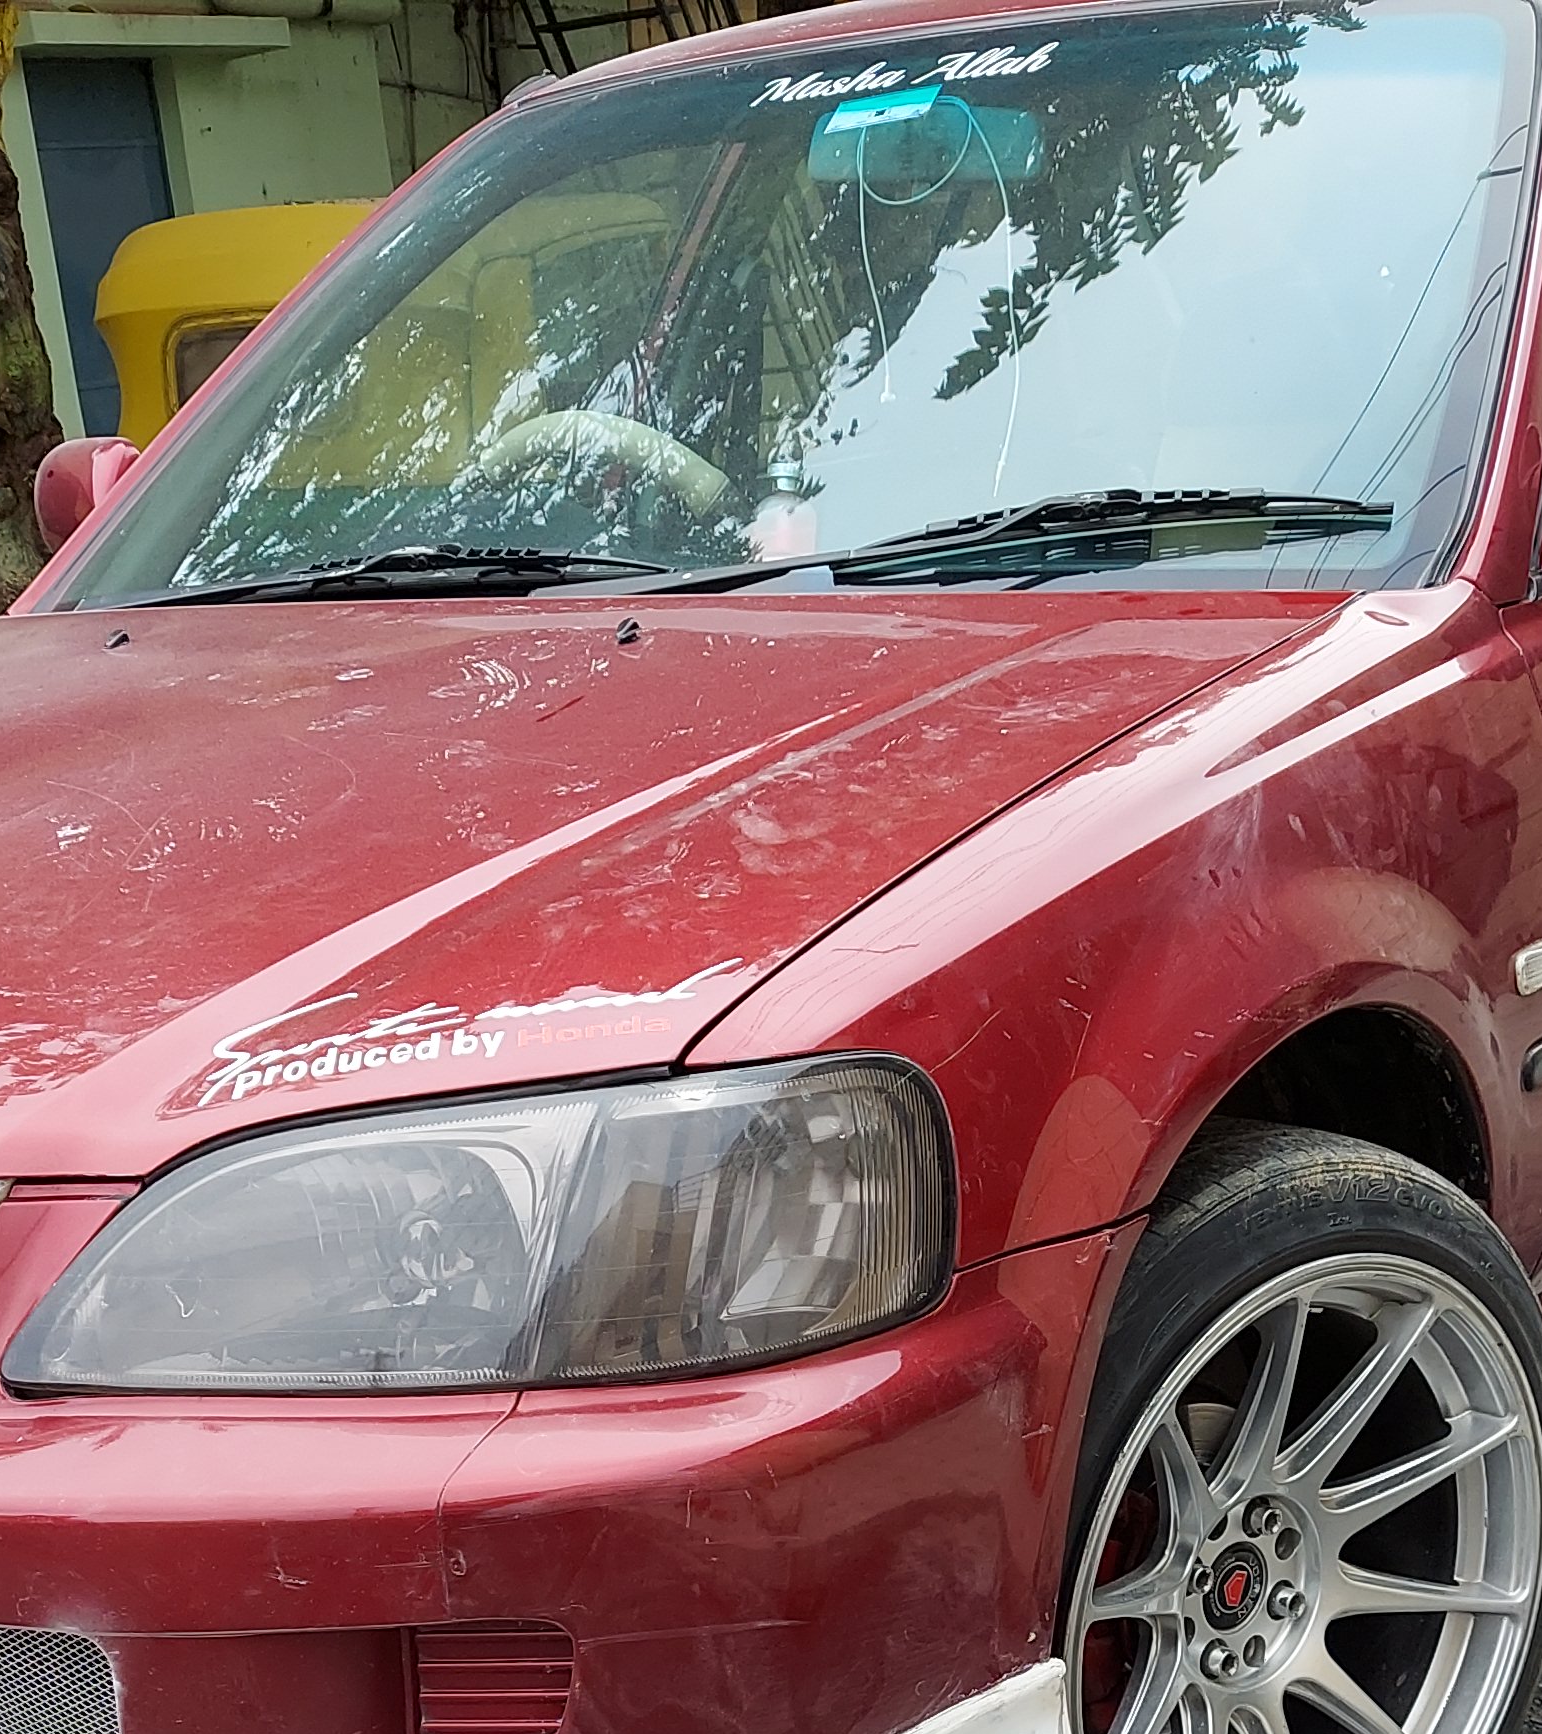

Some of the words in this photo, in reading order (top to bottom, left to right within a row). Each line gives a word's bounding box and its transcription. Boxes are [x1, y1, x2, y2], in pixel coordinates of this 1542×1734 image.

[749, 62, 907, 107] Masha
[910, 42, 1059, 85] Allah
[231, 1031, 441, 1100] produced
[450, 1028, 506, 1058] by
[517, 1014, 673, 1048] Honda
